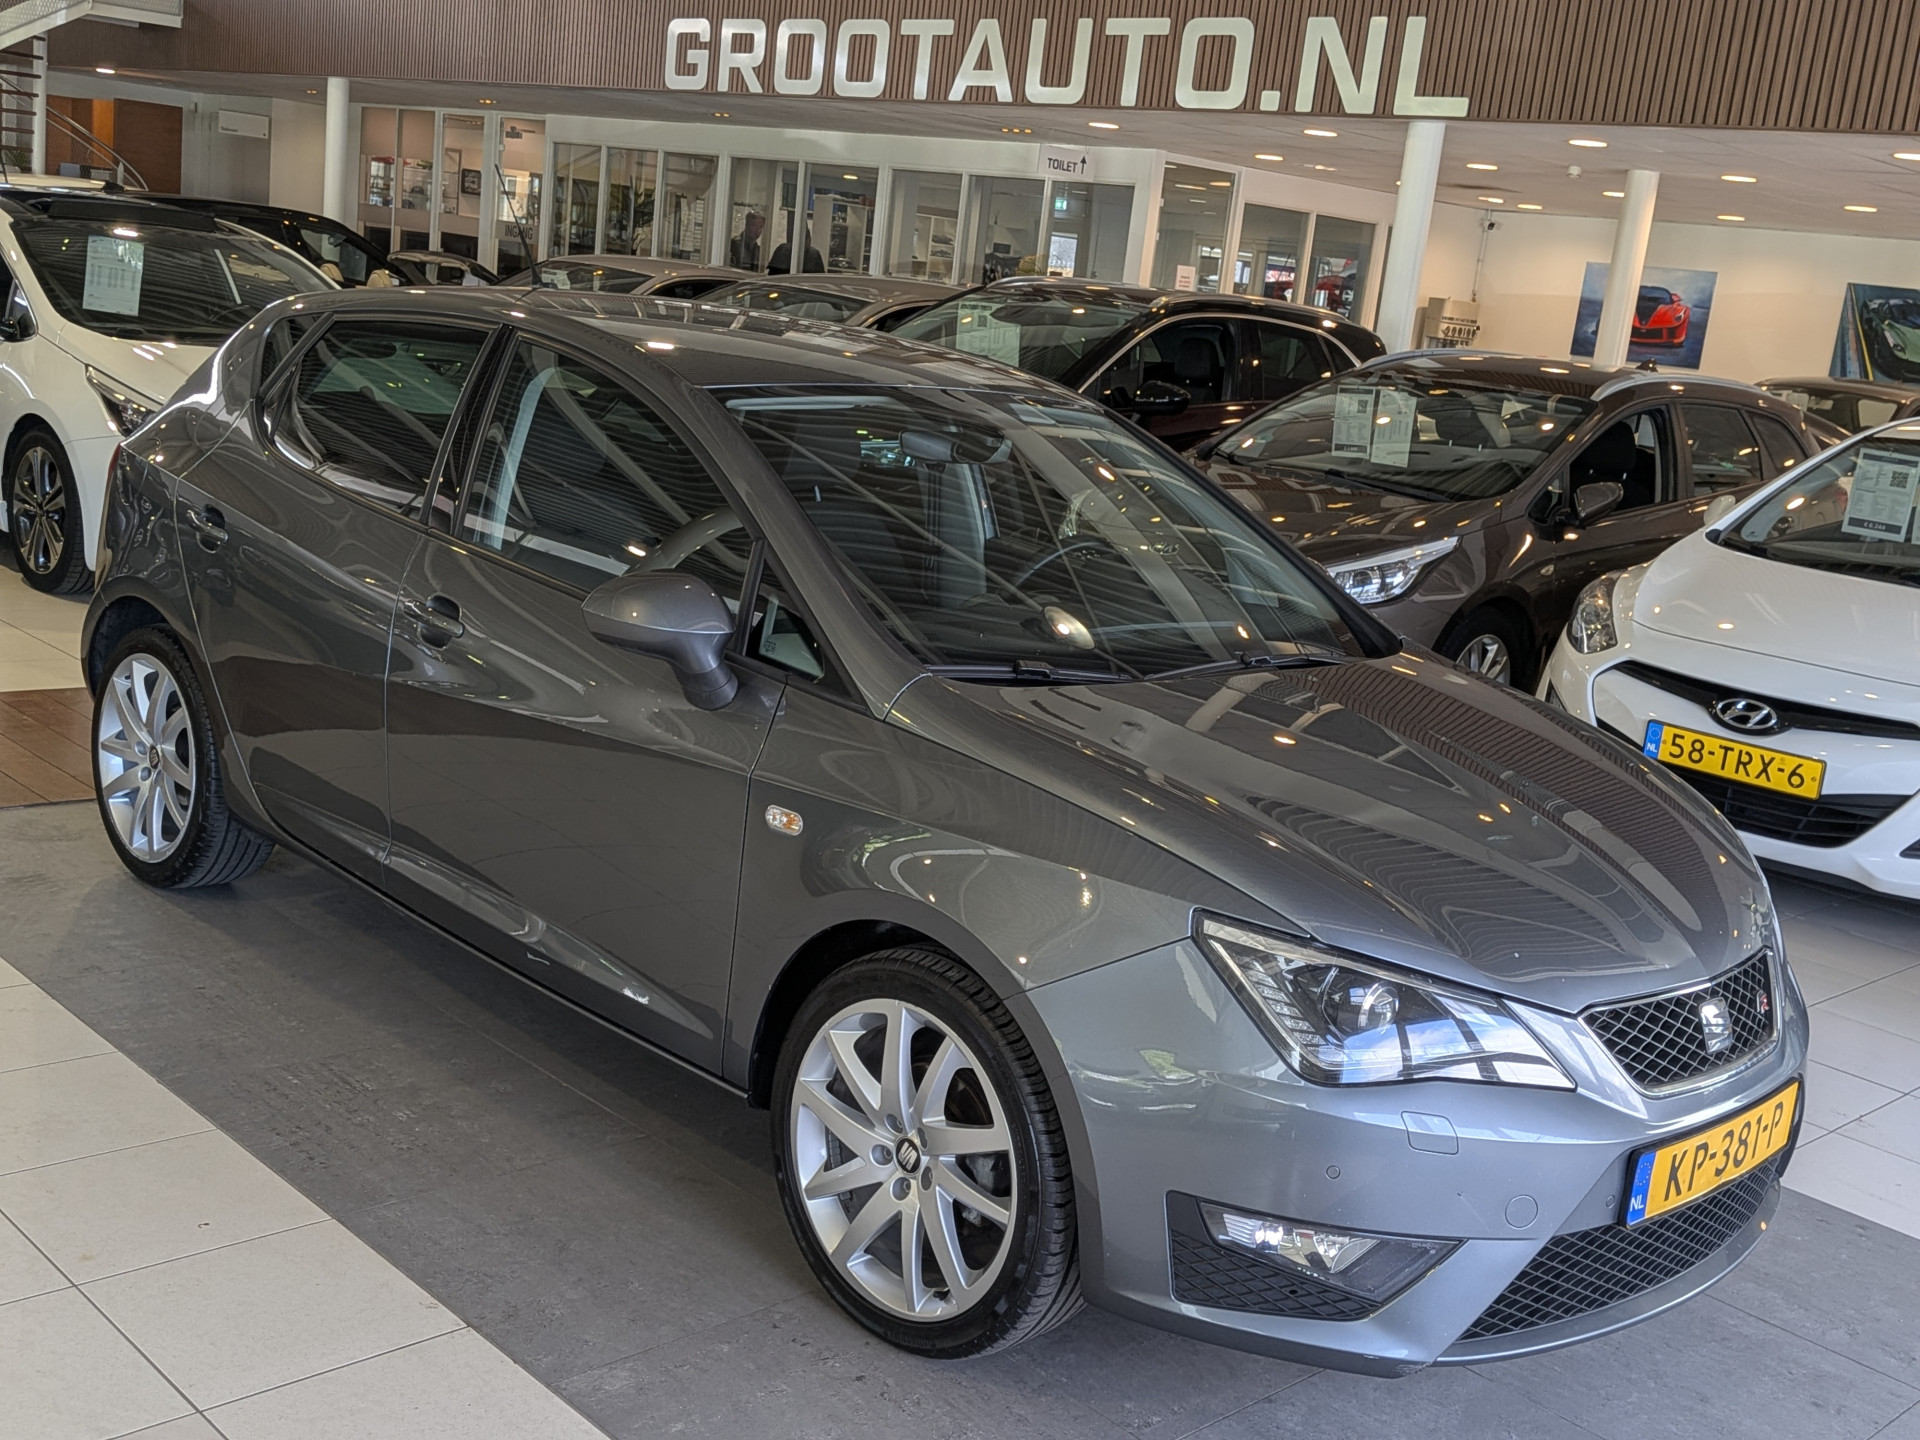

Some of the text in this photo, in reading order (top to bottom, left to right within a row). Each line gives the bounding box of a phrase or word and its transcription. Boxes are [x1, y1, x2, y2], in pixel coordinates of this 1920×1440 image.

[665, 16, 1470, 117] GROOTAUTO.NL
[1047, 157, 1078, 174] TOILET
[1646, 742, 1657, 753] NL
[1668, 733, 1805, 789] 58-TRX-6
[1663, 1101, 1783, 1202] KP-381-P
[1629, 1194, 1644, 1212] NL
